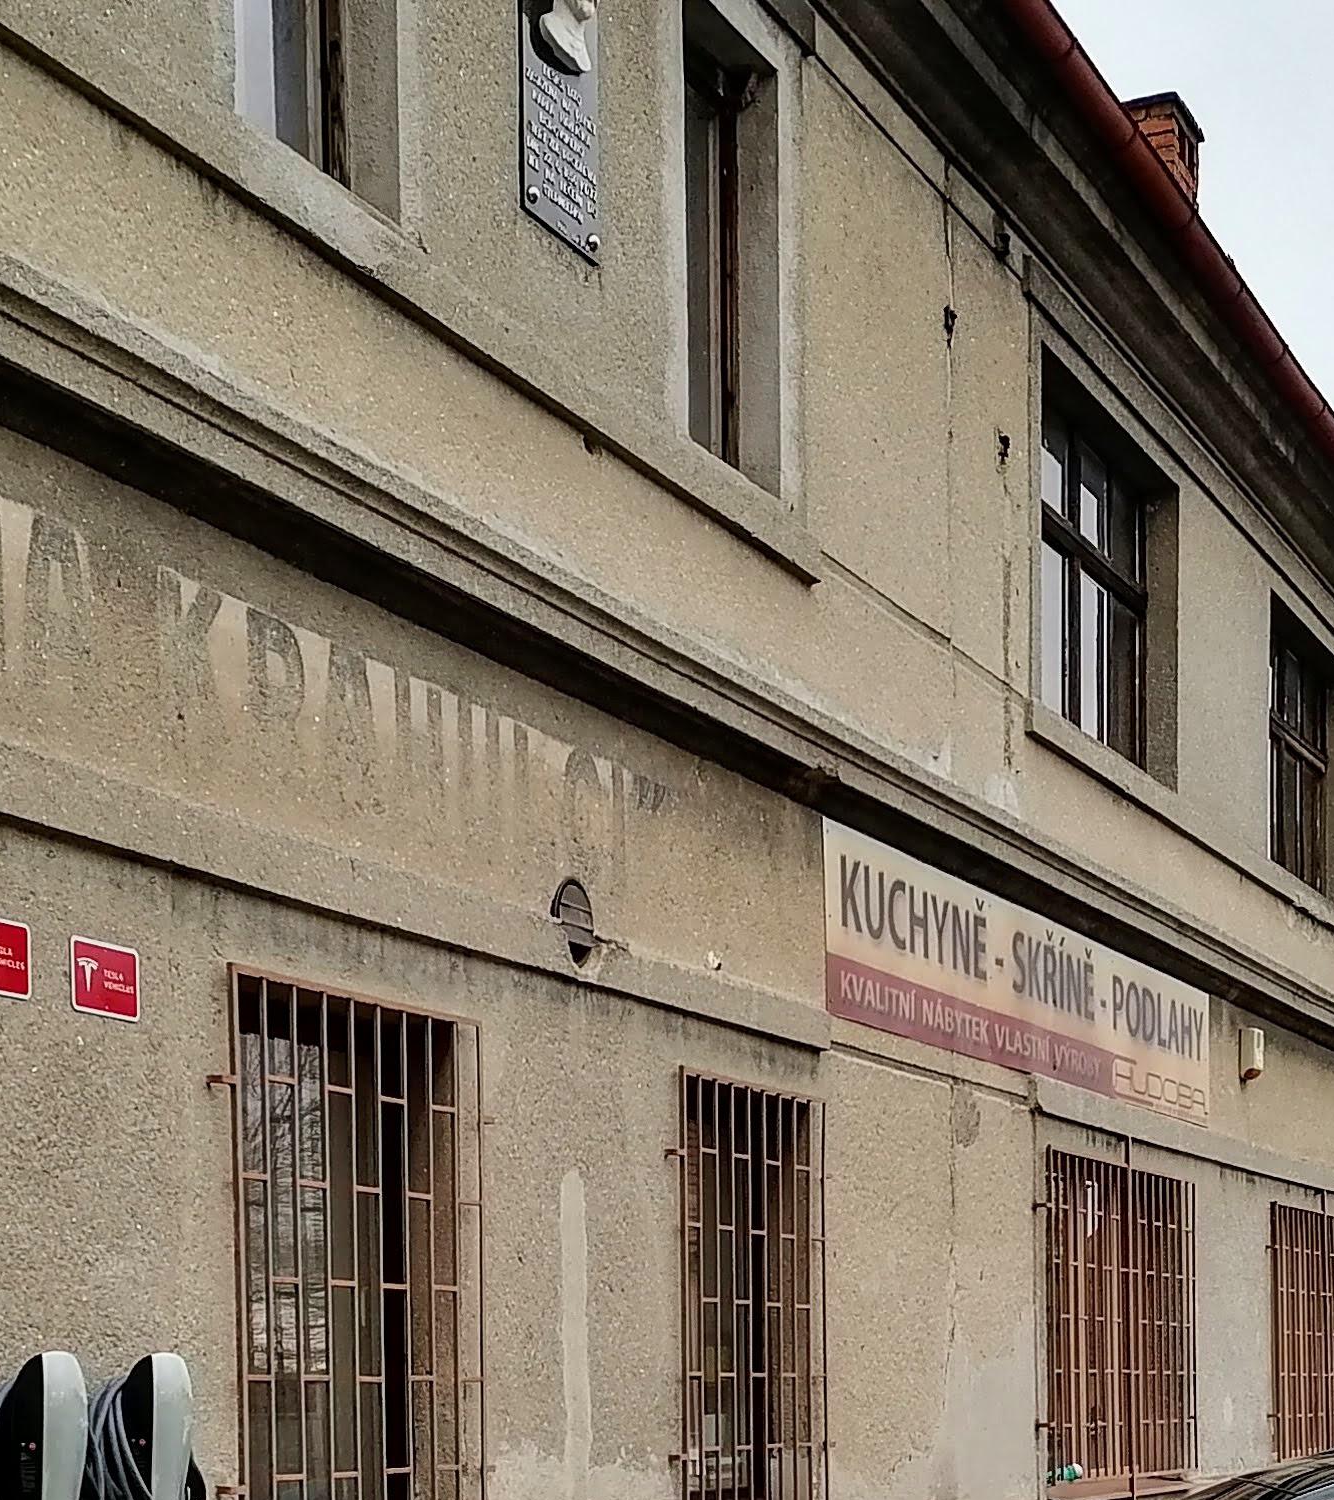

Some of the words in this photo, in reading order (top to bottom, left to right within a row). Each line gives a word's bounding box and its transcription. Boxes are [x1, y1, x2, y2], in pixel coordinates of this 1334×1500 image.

[103, 969, 124, 982] TESLA
[840, 854, 987, 981] KUCHYNĚ
[1012, 929, 1095, 1021] SKŘÍNĚ
[1112, 974, 1204, 1061] PODLAHY
[103, 981, 135, 994] VEHICLES
[840, 971, 915, 1021] KVALITNÍ
[922, 998, 989, 1044] NÁBYTEK
[995, 1023, 1050, 1063] VLASTNÍ
